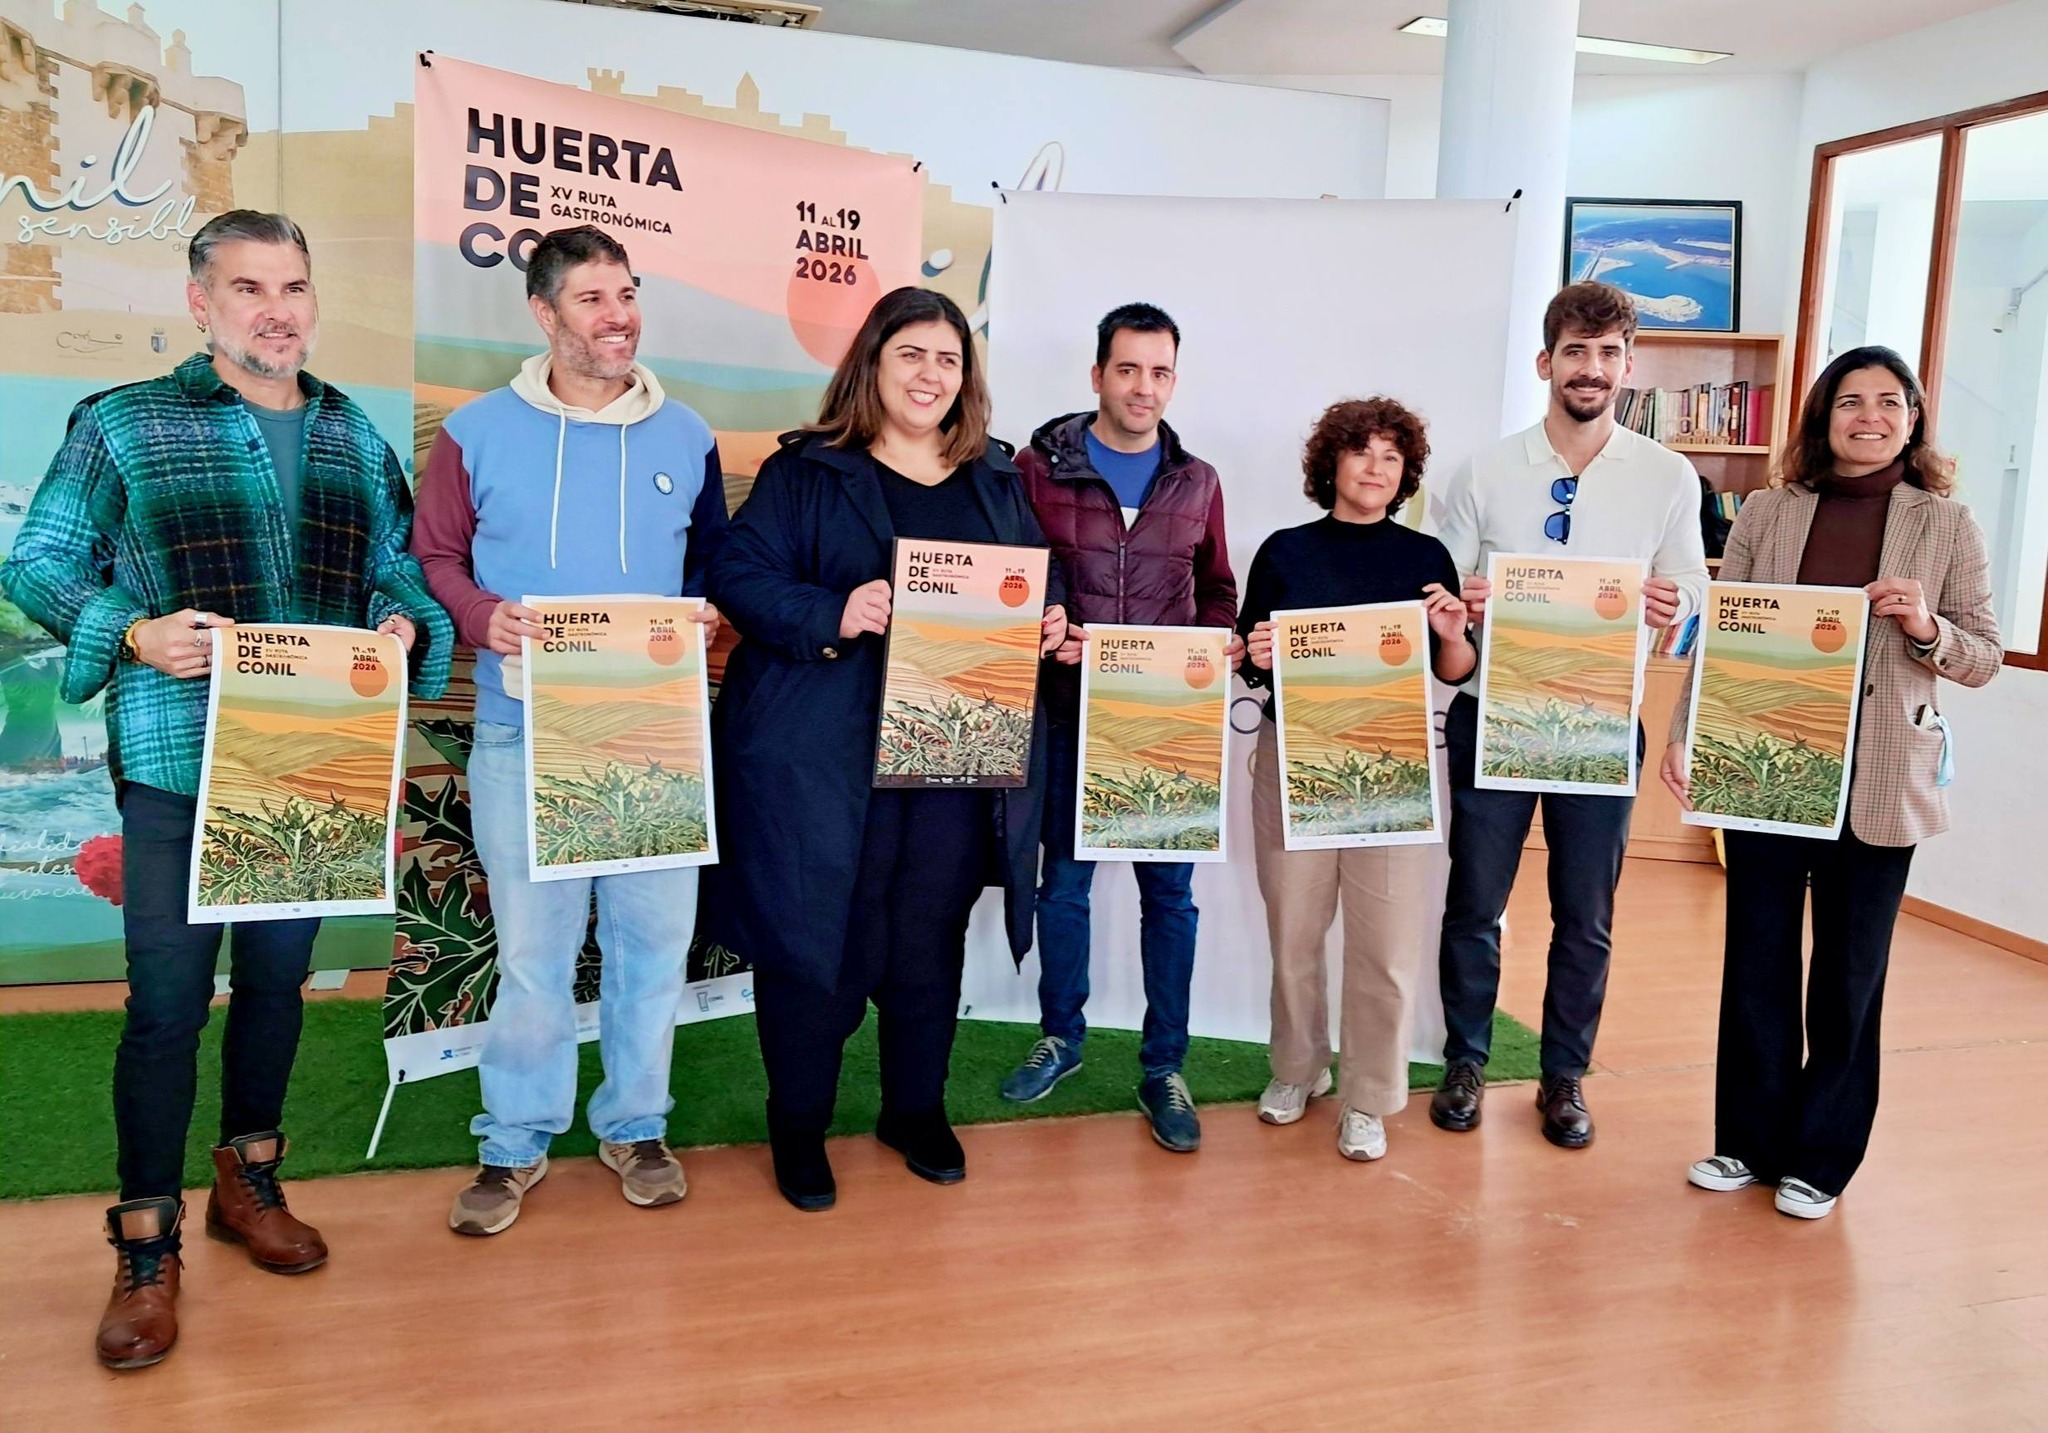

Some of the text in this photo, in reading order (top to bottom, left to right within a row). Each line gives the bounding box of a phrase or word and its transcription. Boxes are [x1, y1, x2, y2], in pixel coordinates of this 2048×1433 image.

[467, 107, 684, 192] HUERTA
[463, 164, 541, 220] DE
[550, 186, 617, 208] XV RUTA
[17, 195, 198, 244] sensibl
[550, 204, 673, 234] GASTRONÓMICA
[796, 200, 861, 231] 11 AL 19
[795, 229, 869, 260] ABRIL
[796, 257, 857, 286] 2026
[909, 551, 974, 567] HUERTA
[908, 565, 930, 578] DE
[1505, 567, 1565, 580] HUERTA
[907, 580, 959, 595] CONIL
[1505, 579, 1525, 590] DE
[1503, 591, 1551, 604] CONIL
[1720, 596, 1780, 610] HUERTA
[543, 612, 611, 625] HUERTA
[1719, 608, 1739, 620] DE
[1815, 616, 1842, 624] ABRIL
[649, 626, 677, 634] ABRIL
[1289, 622, 1346, 635] HUERTA
[1718, 621, 1767, 634] CONIL
[1815, 623, 1838, 631] 2026
[236, 631, 311, 647] HUERTA
[650, 634, 673, 642] 2026
[1290, 636, 1308, 647] DE
[543, 640, 597, 653] CONIL
[1100, 639, 1155, 651] HUERTA
[237, 645, 262, 659] DE
[352, 654, 381, 663] ABRIL
[1100, 651, 1118, 661] DE
[1290, 647, 1336, 659] CONIL
[236, 660, 297, 676] CONIL
[352, 662, 377, 671] 2026
[1099, 663, 1143, 674] CONIL
